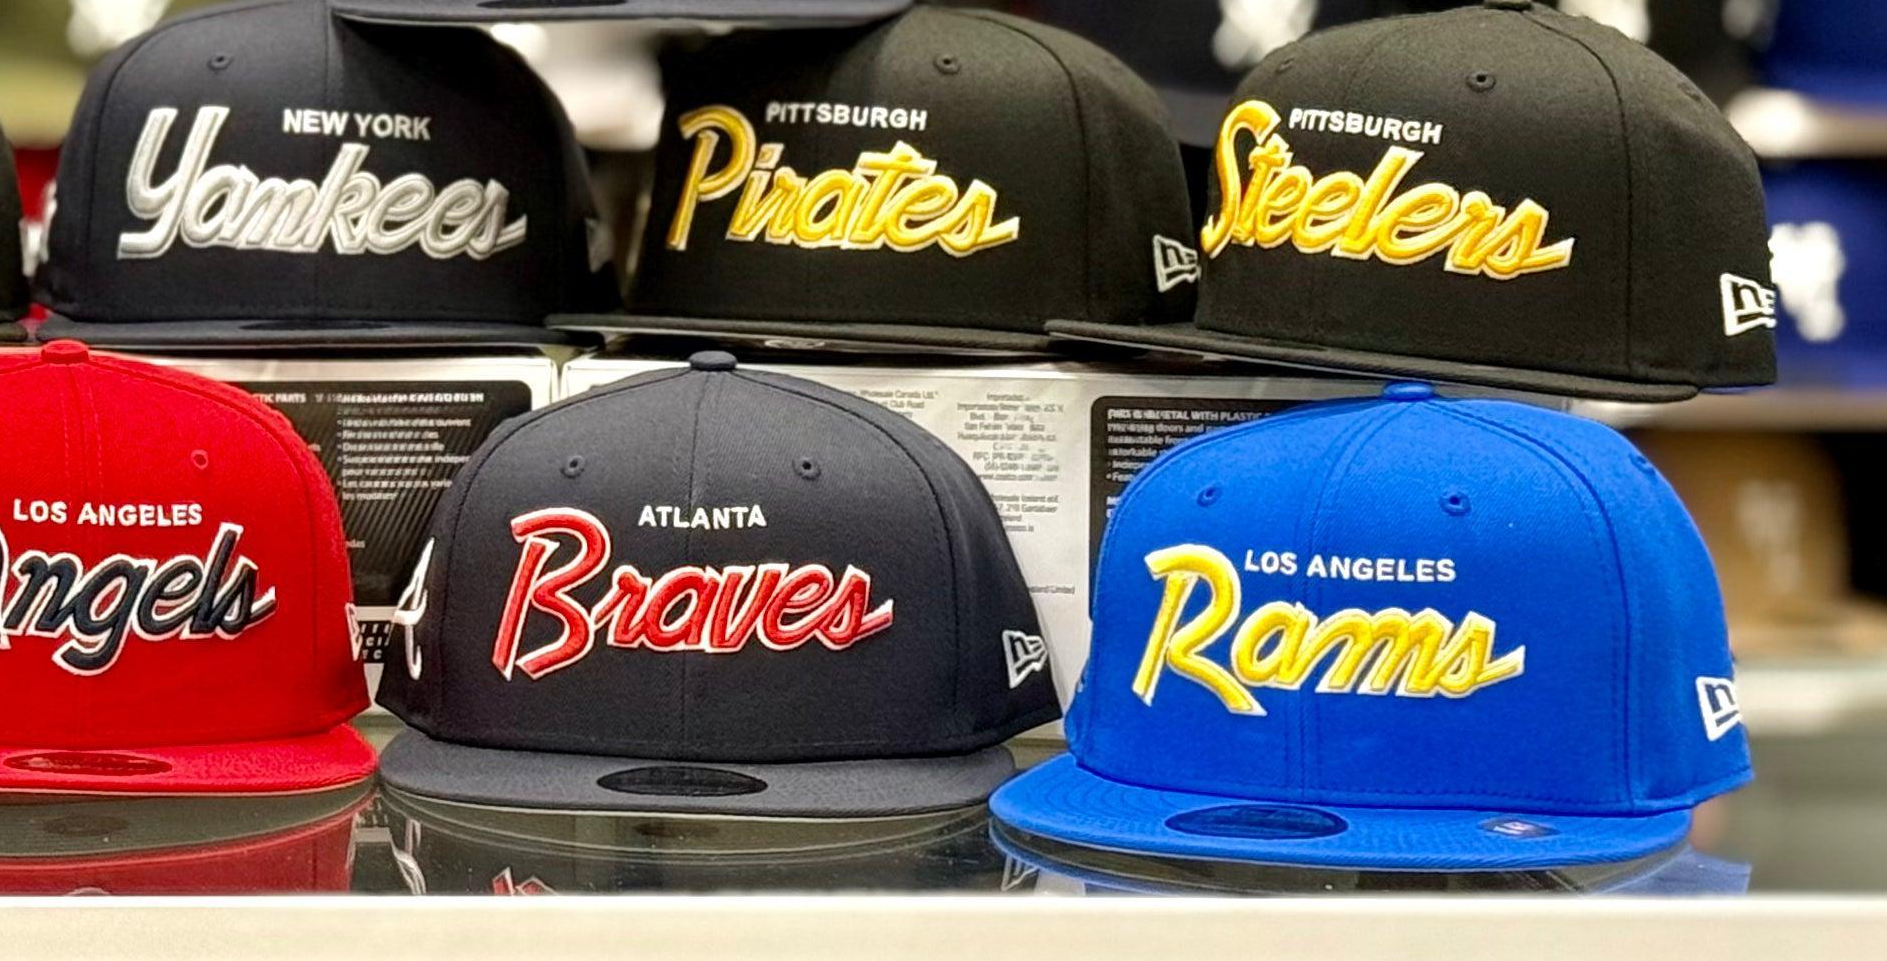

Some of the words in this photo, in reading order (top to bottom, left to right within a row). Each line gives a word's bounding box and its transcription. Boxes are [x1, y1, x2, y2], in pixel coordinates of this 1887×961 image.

[283, 108, 349, 137] NEW
[354, 111, 431, 141] YORK
[766, 101, 928, 131] PITTSBURGH
[1288, 107, 1443, 145] PITTSBURGH
[116, 106, 528, 262] Yankees
[669, 103, 1021, 258] Pirates
[1200, 99, 1576, 280] Steelers
[12, 498, 68, 524] LOS
[77, 501, 203, 527] ANGELES
[637, 503, 767, 529] ATLANTA
[1244, 548, 1297, 576] LOS
[1307, 555, 1457, 584] ANGELES
[491, 505, 894, 681] Braves
[1131, 542, 1527, 717] Rams
